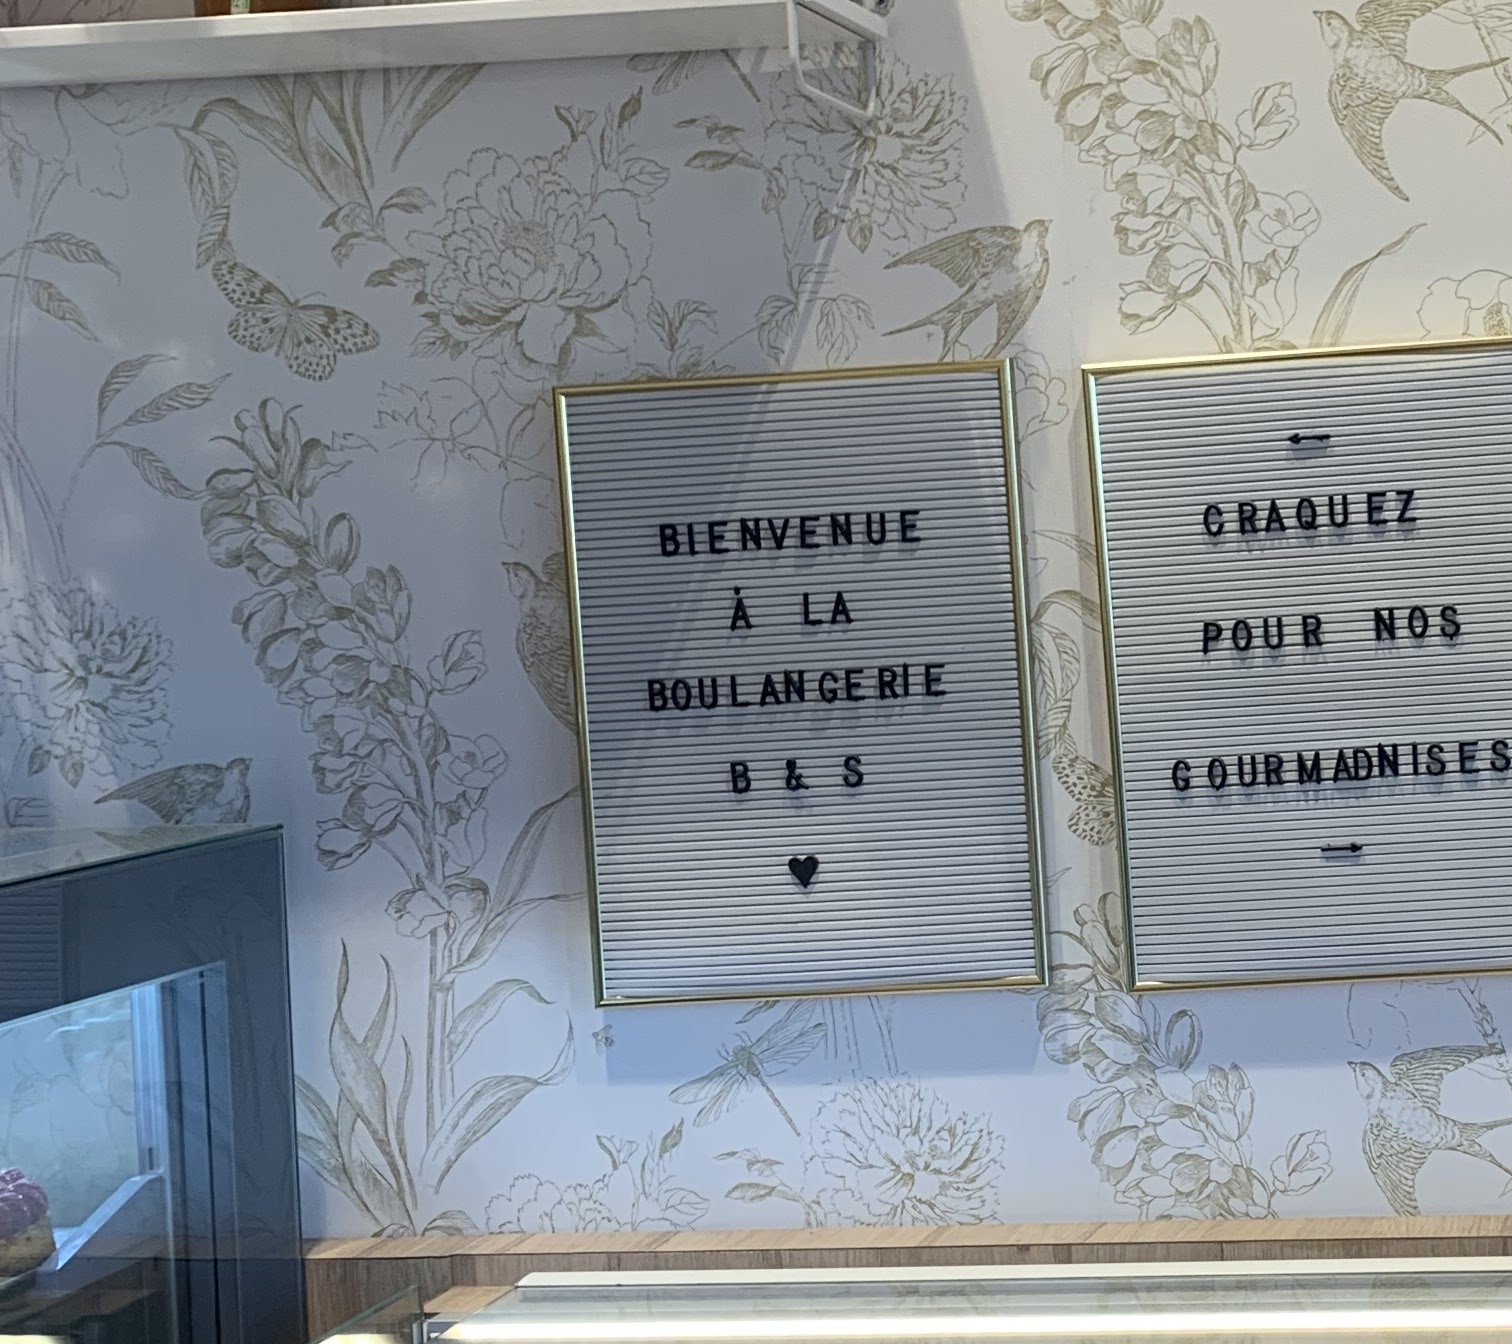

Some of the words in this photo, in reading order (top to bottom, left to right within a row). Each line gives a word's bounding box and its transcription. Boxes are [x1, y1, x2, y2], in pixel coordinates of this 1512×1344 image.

[659, 510, 922, 558] BIENVENUE
[1202, 491, 1417, 539] CRAQUEZ
[802, 593, 852, 626] LA
[1202, 614, 1324, 654] POUR
[1374, 605, 1462, 643] NOS
[647, 663, 947, 712] BOULANGERIE
[730, 762, 750, 793] B
[785, 758, 809, 791] &
[843, 755, 863, 788] S
[1171, 739, 1512, 792] GOURMADNISES
